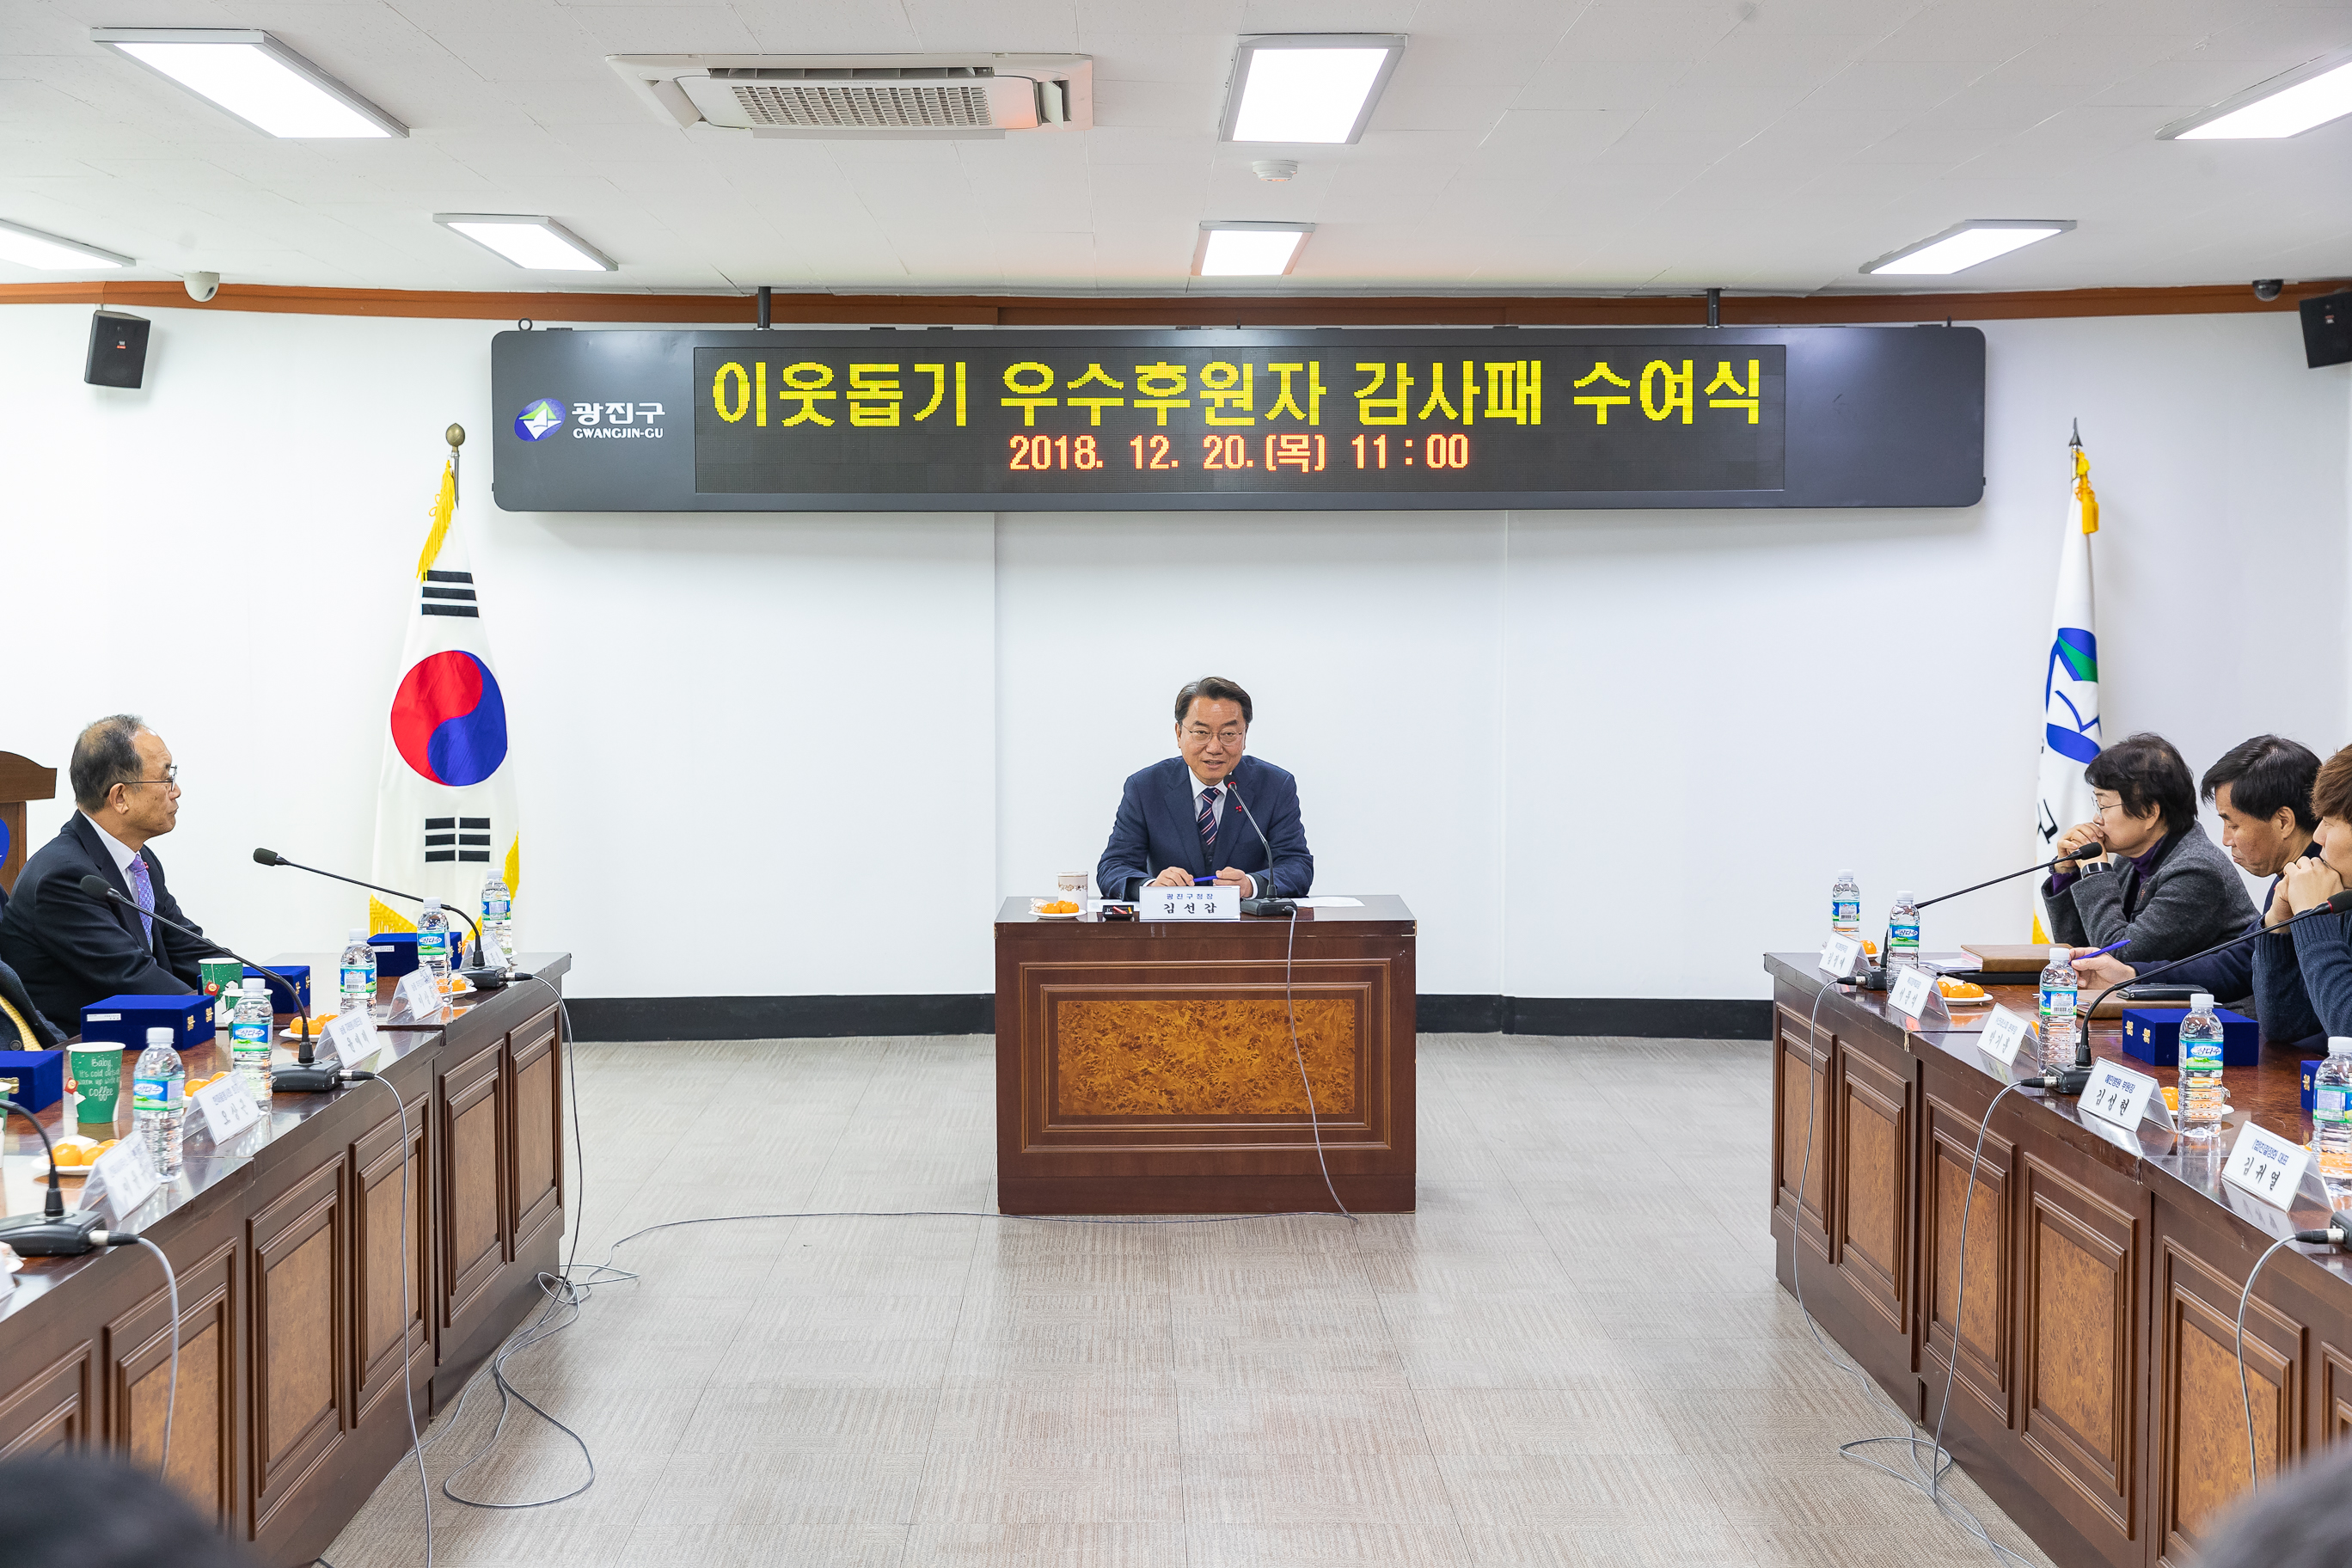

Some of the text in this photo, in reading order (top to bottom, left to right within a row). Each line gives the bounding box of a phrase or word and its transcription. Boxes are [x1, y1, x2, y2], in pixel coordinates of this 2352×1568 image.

[712, 358, 1761, 427] 이웃돕기 우수후원자 감사패 수여식
[572, 401, 666, 426] 광진구
[573, 427, 665, 439] GWANGJIN-GU
[1008, 434, 1104, 470] 2018.
[1130, 434, 1179, 470] 12.
